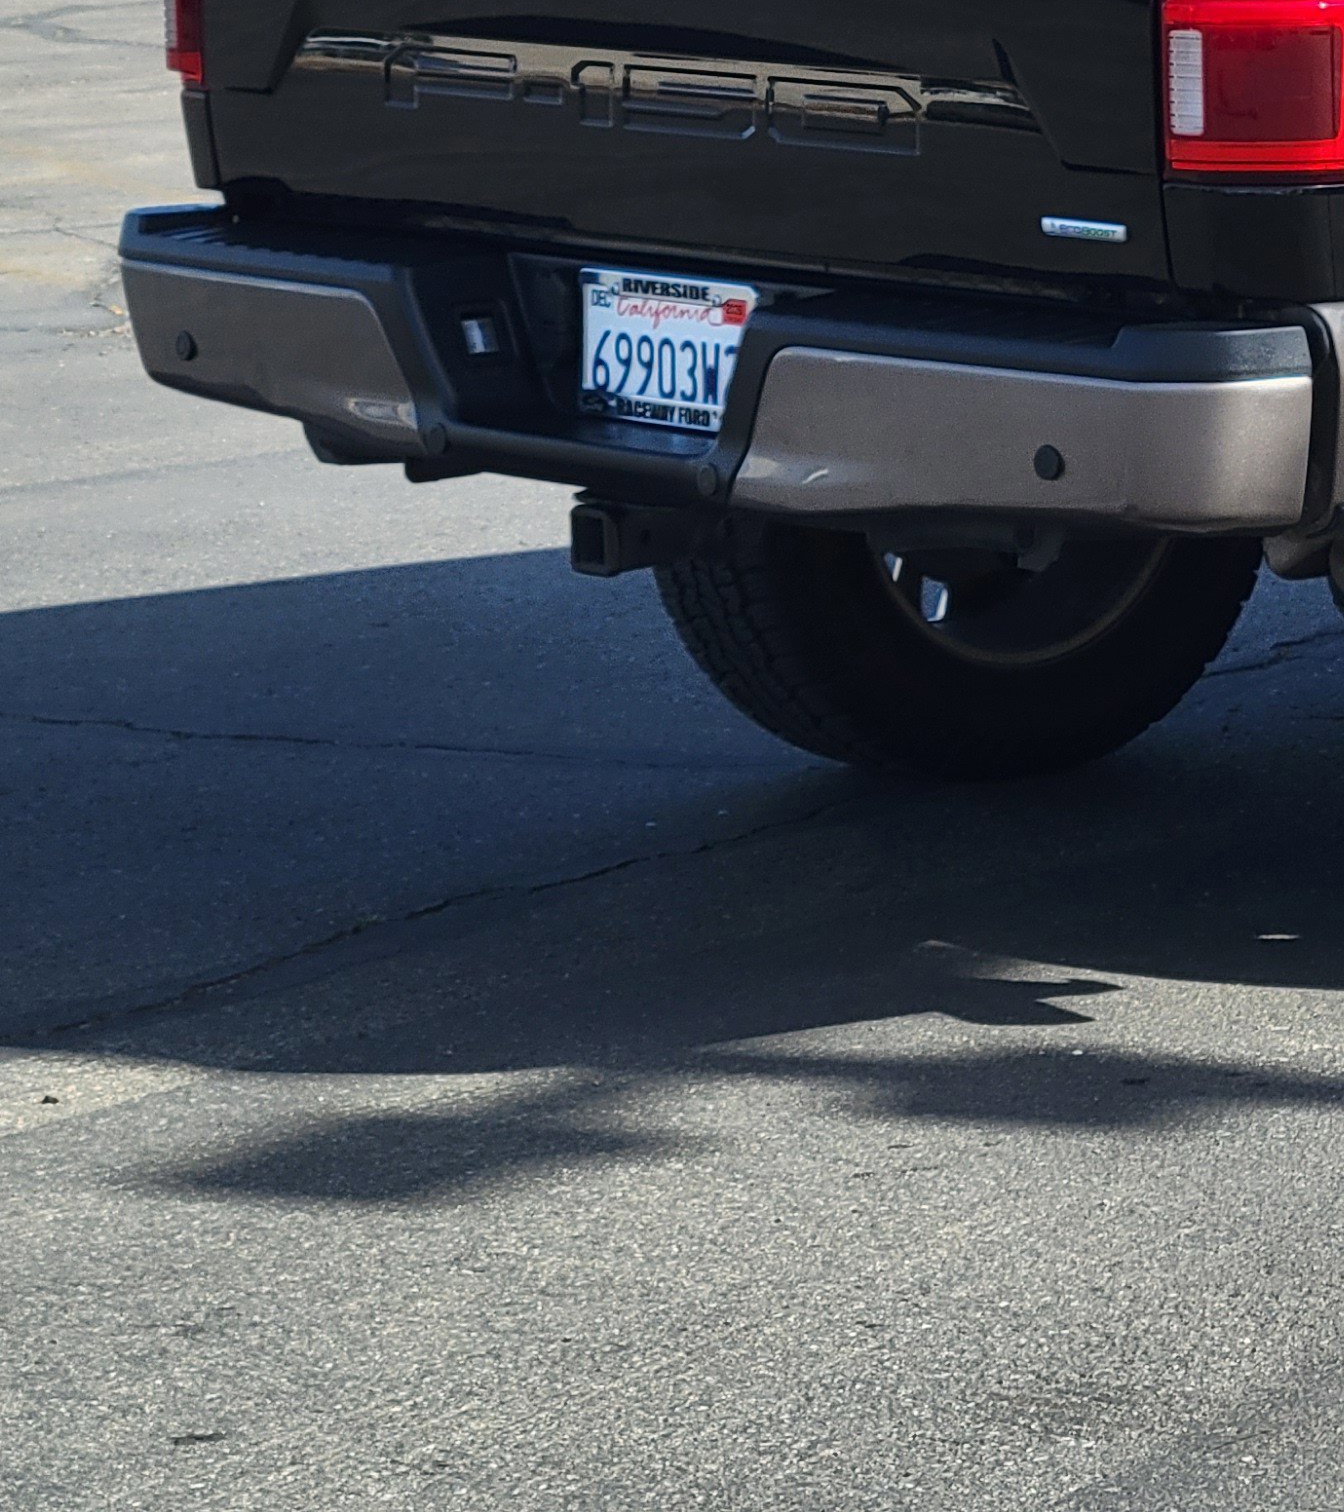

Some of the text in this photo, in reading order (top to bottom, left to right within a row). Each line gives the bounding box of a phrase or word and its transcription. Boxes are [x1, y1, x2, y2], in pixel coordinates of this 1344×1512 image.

[591, 289, 612, 308] DEC
[622, 277, 711, 302] RIVERSIDE
[616, 296, 716, 329] California
[678, 406, 712, 428] FORD
